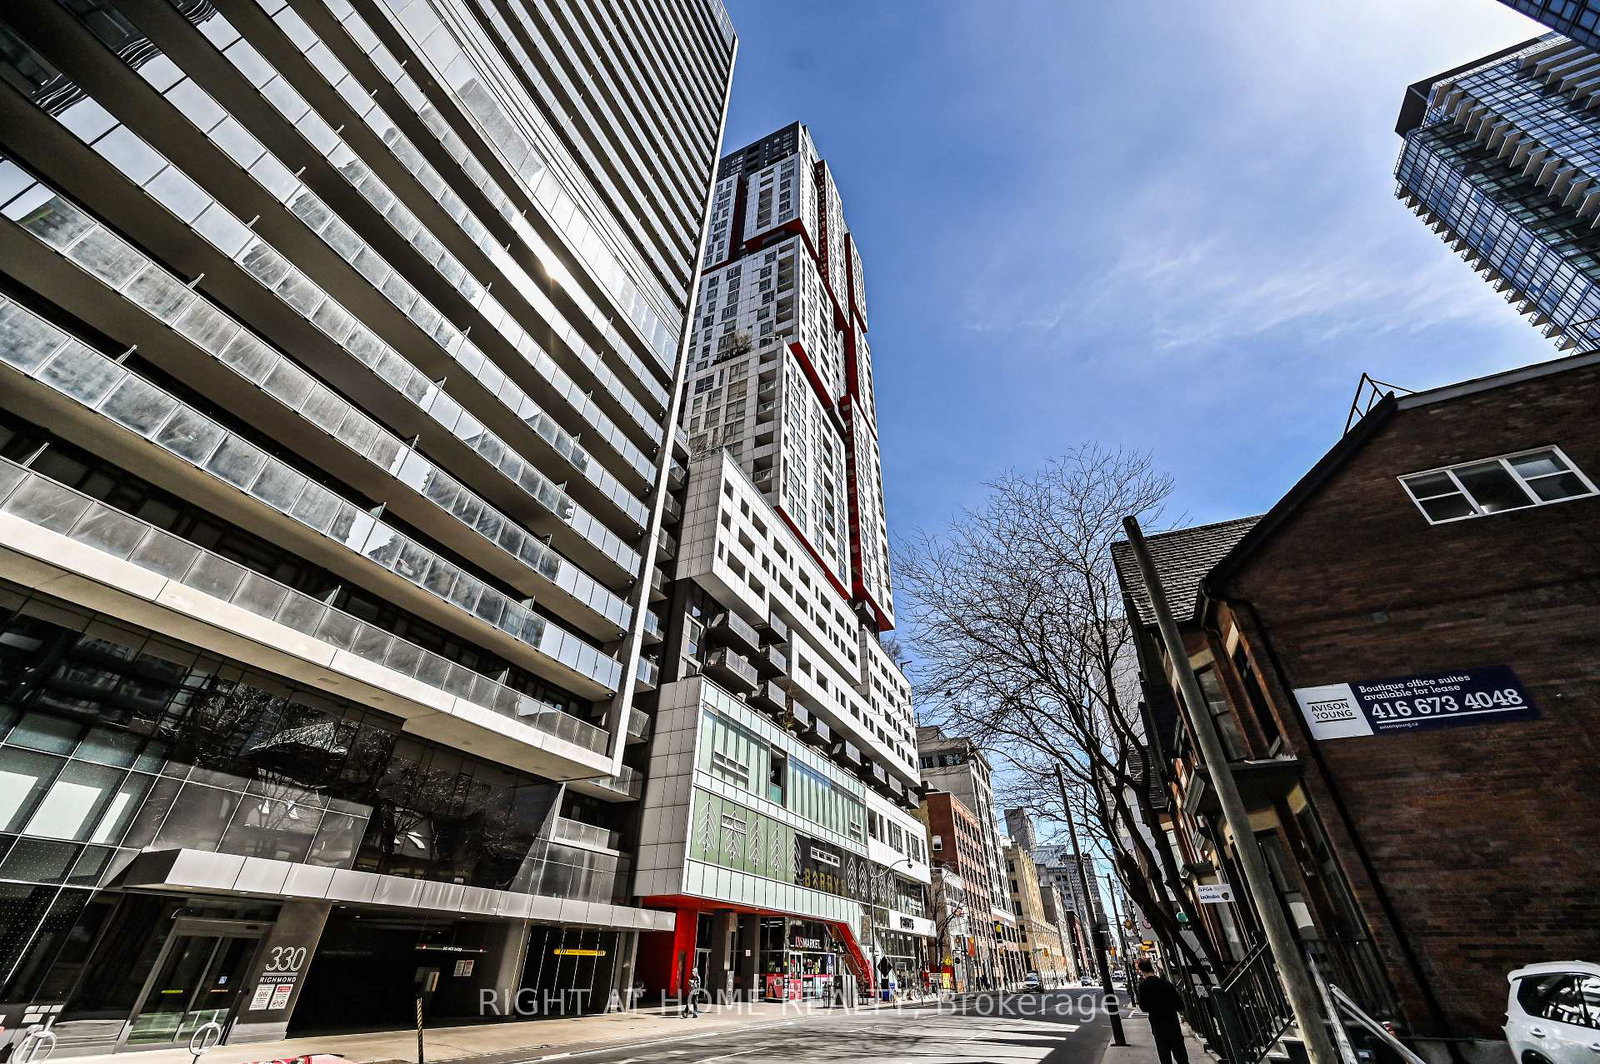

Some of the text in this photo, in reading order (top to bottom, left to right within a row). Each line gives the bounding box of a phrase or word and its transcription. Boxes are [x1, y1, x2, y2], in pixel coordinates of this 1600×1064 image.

[1358, 674, 1471, 693] Boutique office suites
[1363, 684, 1461, 701] available for lease
[1311, 702, 1350, 713] AVISON
[1371, 689, 1523, 719] 416 673 4048
[1313, 709, 1353, 720] YOUNG
[265, 946, 307, 972] 330
